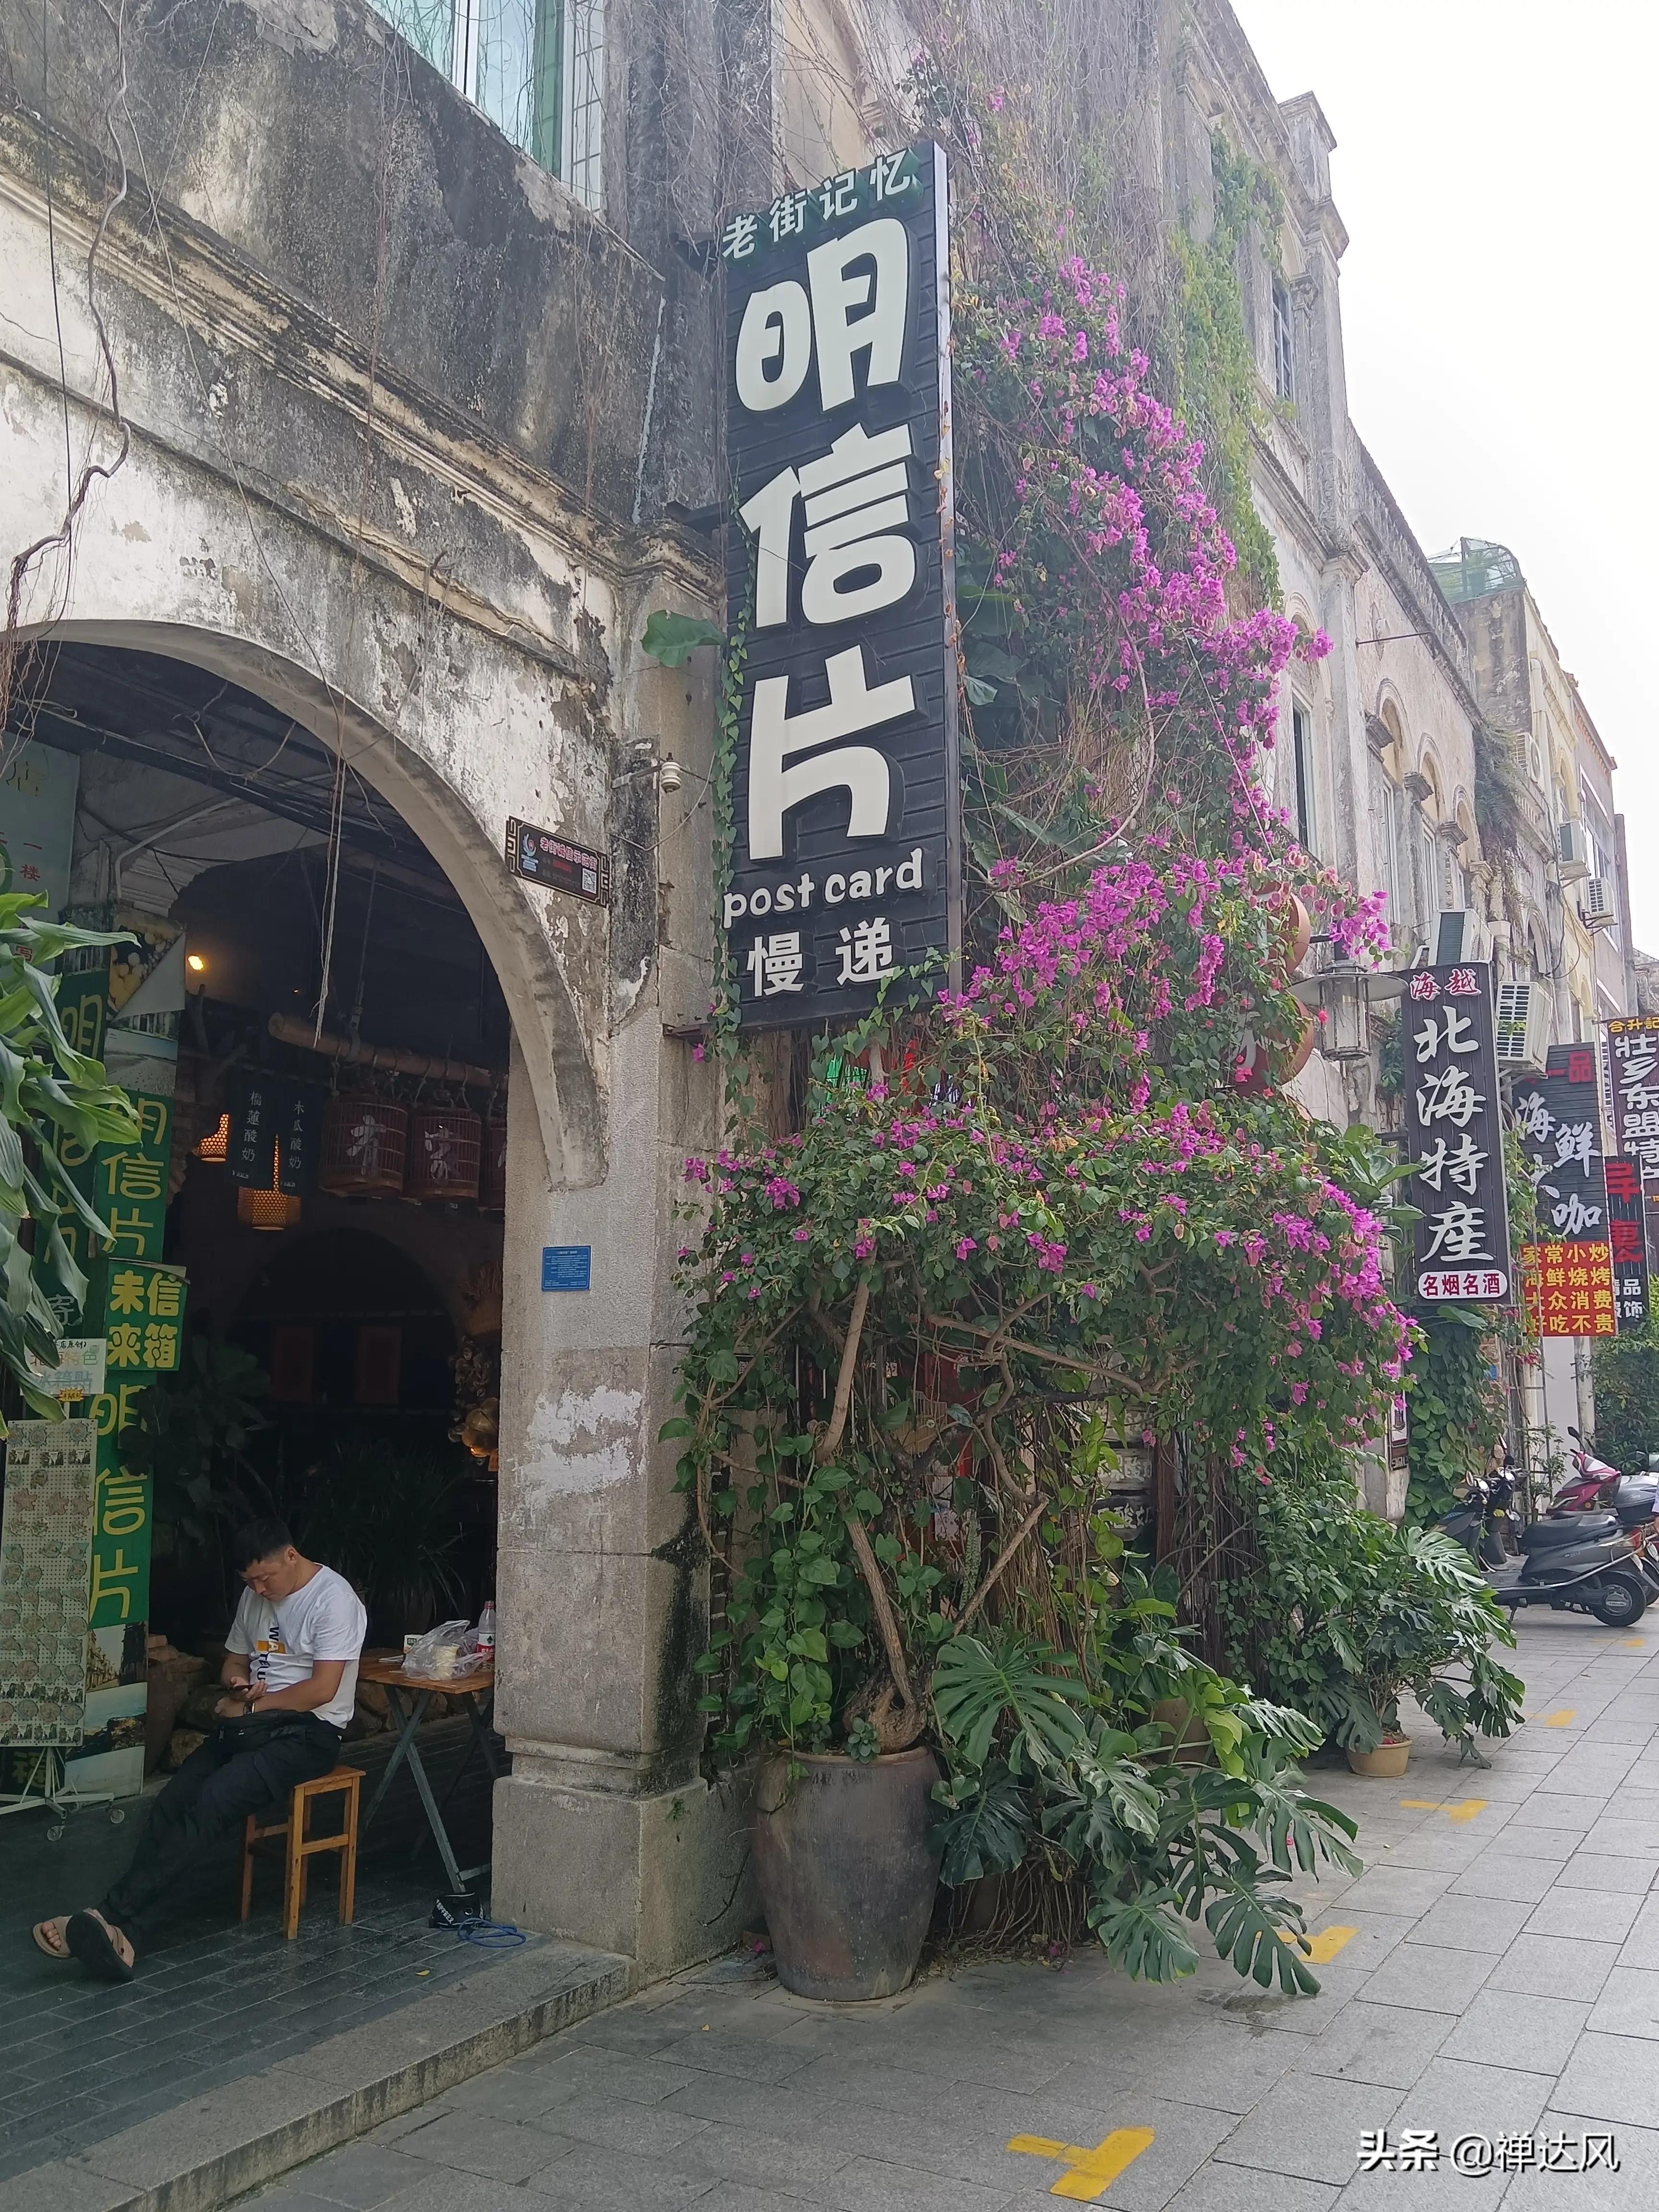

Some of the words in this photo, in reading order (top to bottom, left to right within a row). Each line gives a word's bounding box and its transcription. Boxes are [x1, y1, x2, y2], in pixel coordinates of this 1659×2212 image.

[721, 149, 914, 260] 老街记忆
[735, 218, 916, 860] 明信片
[722, 872, 815, 929] post
[825, 848, 923, 904] card
[746, 916, 897, 997] 慢递
[1409, 968, 1482, 1002] 海越
[289, 1100, 305, 1169] 木瓜酸奶
[1522, 1241, 1611, 1264] 家常小炒
[1526, 1266, 1612, 1288] 海鲜烧烤
[1422, 1272, 1501, 1298] 名烟名酒
[1525, 1289, 1613, 1311] 大众消费
